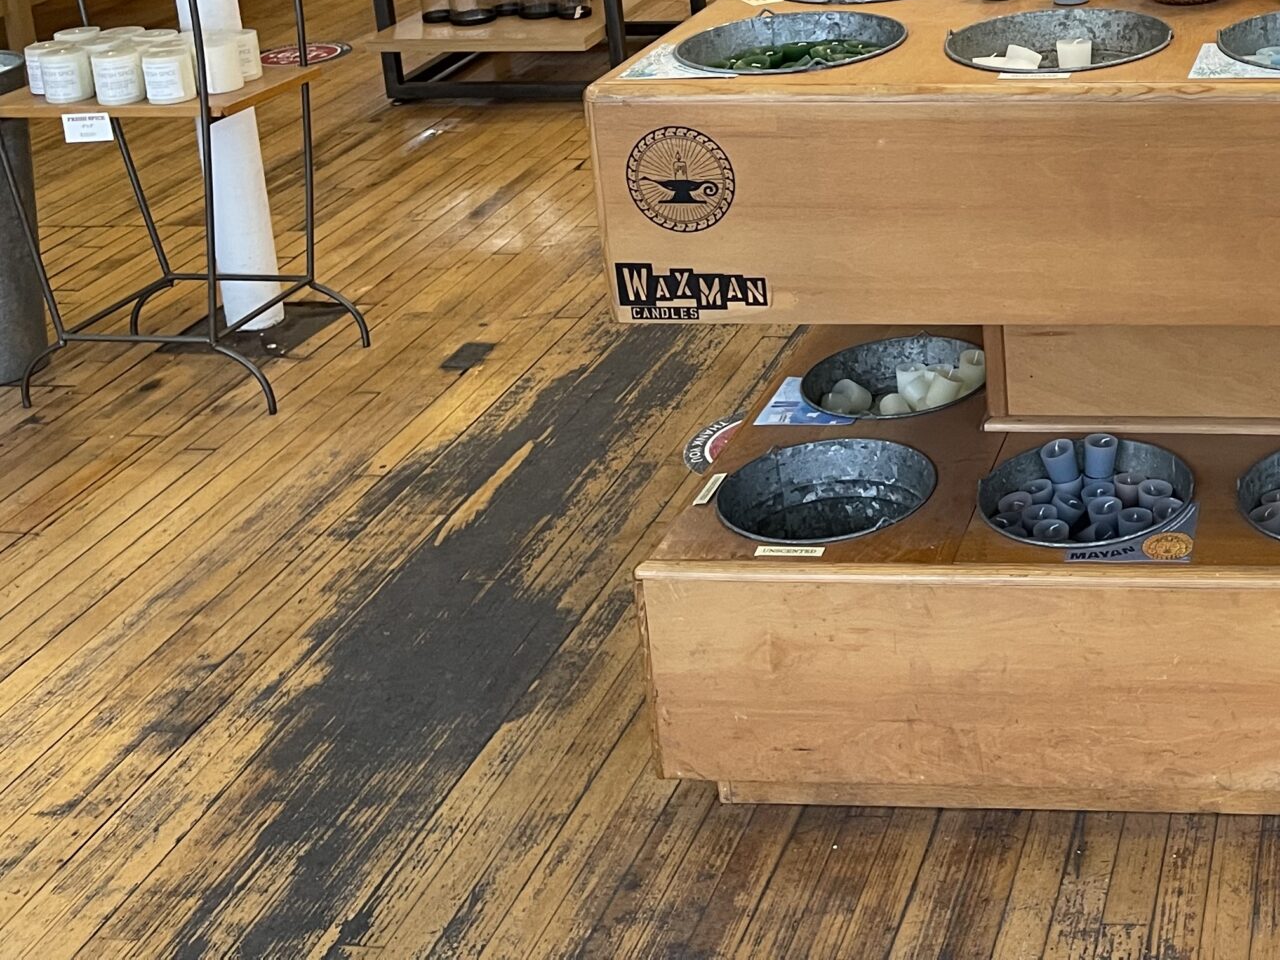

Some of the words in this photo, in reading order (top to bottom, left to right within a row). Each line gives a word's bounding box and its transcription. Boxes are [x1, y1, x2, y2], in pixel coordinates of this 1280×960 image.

[619, 266, 766, 307] WAXMAN
[632, 308, 699, 319] CANDLES
[692, 422, 730, 446] THANK
[689, 447, 703, 462] YOU
[1070, 546, 1135, 560] MAYAN
